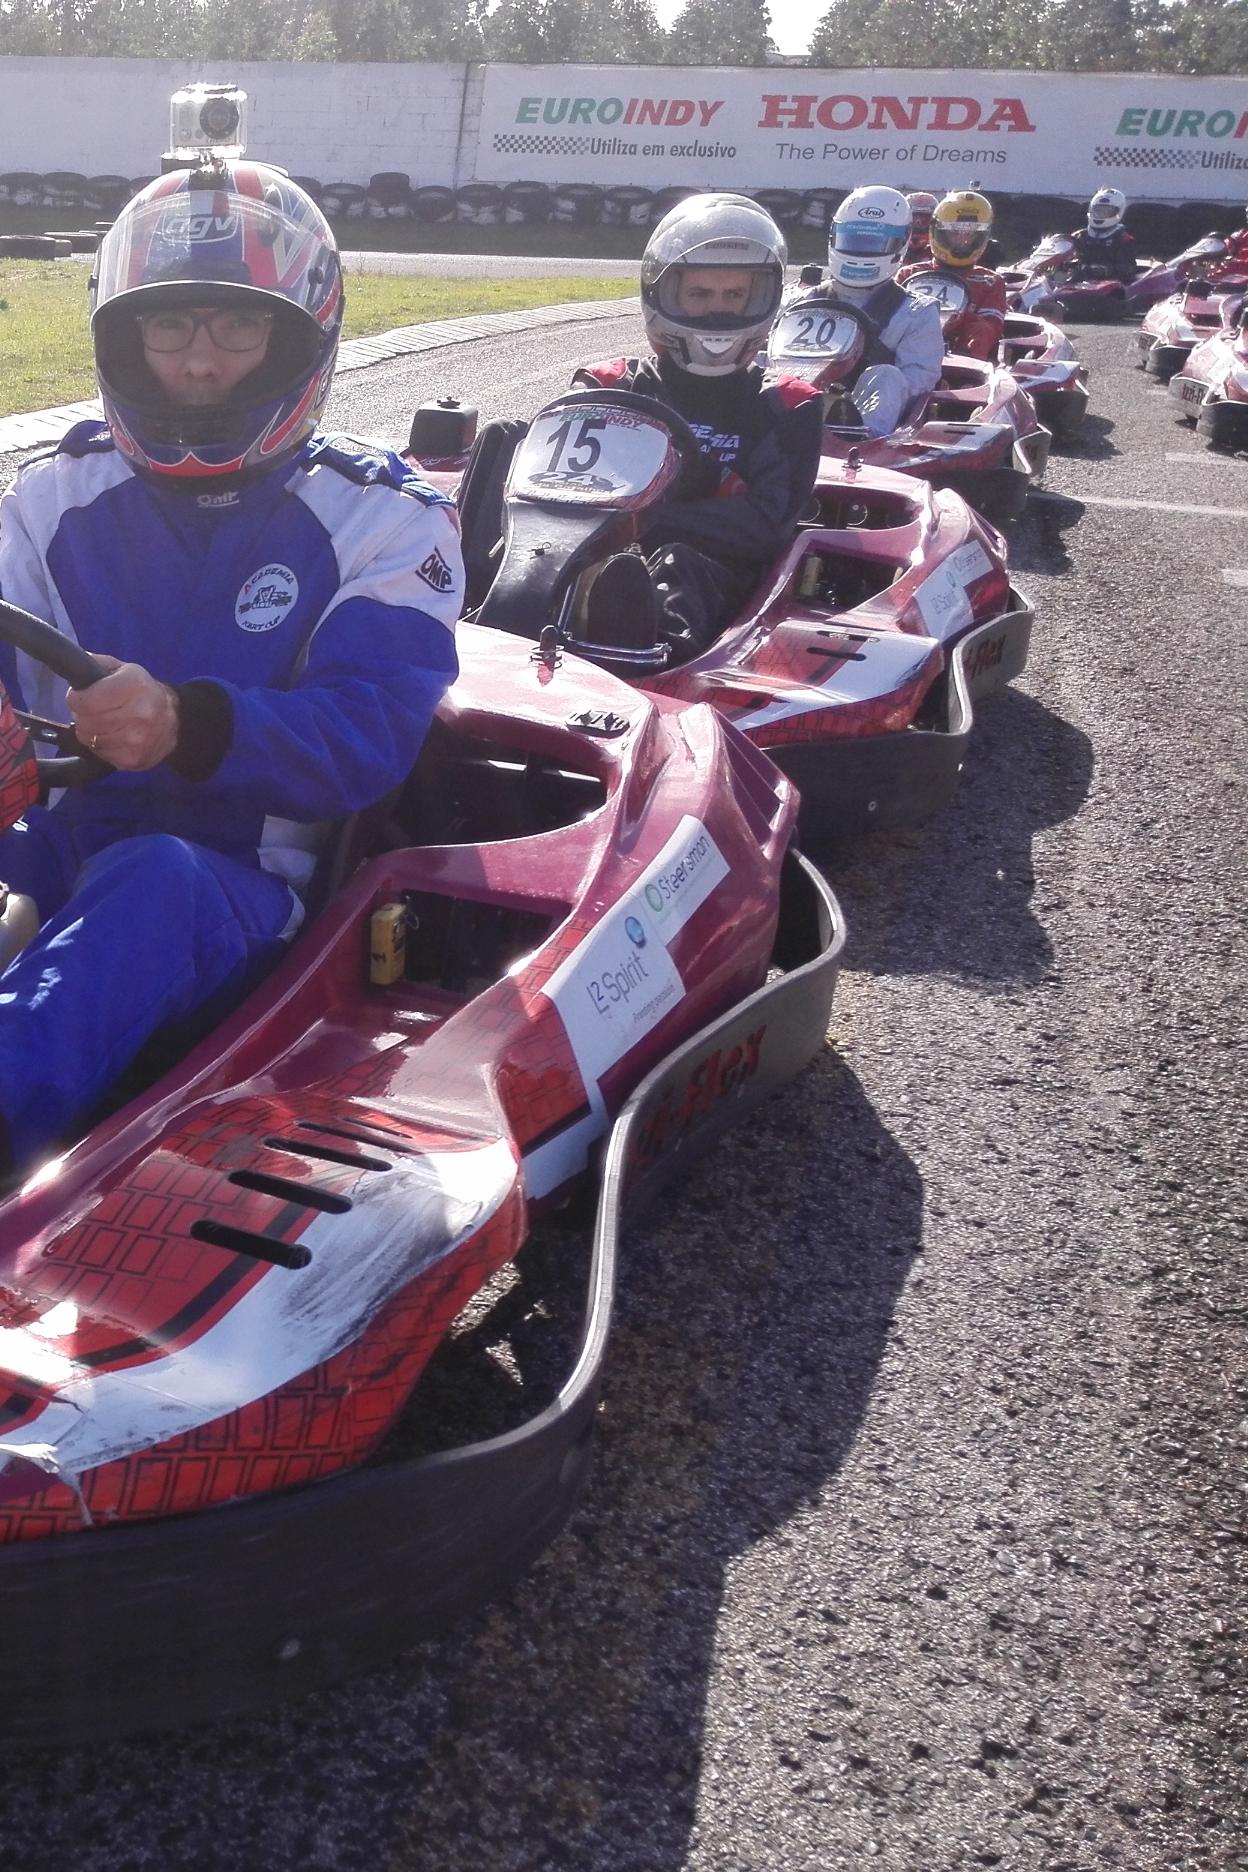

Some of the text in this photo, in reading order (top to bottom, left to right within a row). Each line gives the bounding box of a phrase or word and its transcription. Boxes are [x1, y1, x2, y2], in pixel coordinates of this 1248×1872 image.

[515, 97, 725, 127] EUROINDY
[757, 94, 1037, 132] HONDA
[590, 138, 737, 158] Utiliza em exclusivo
[776, 143, 1007, 164] The Power of Dreams
[165, 215, 236, 239] agv
[791, 316, 837, 346] 20
[546, 418, 602, 473] 15
[540, 470, 594, 486] 24
[420, 553, 453, 590] OMP
[658, 835, 711, 899] Steersman
